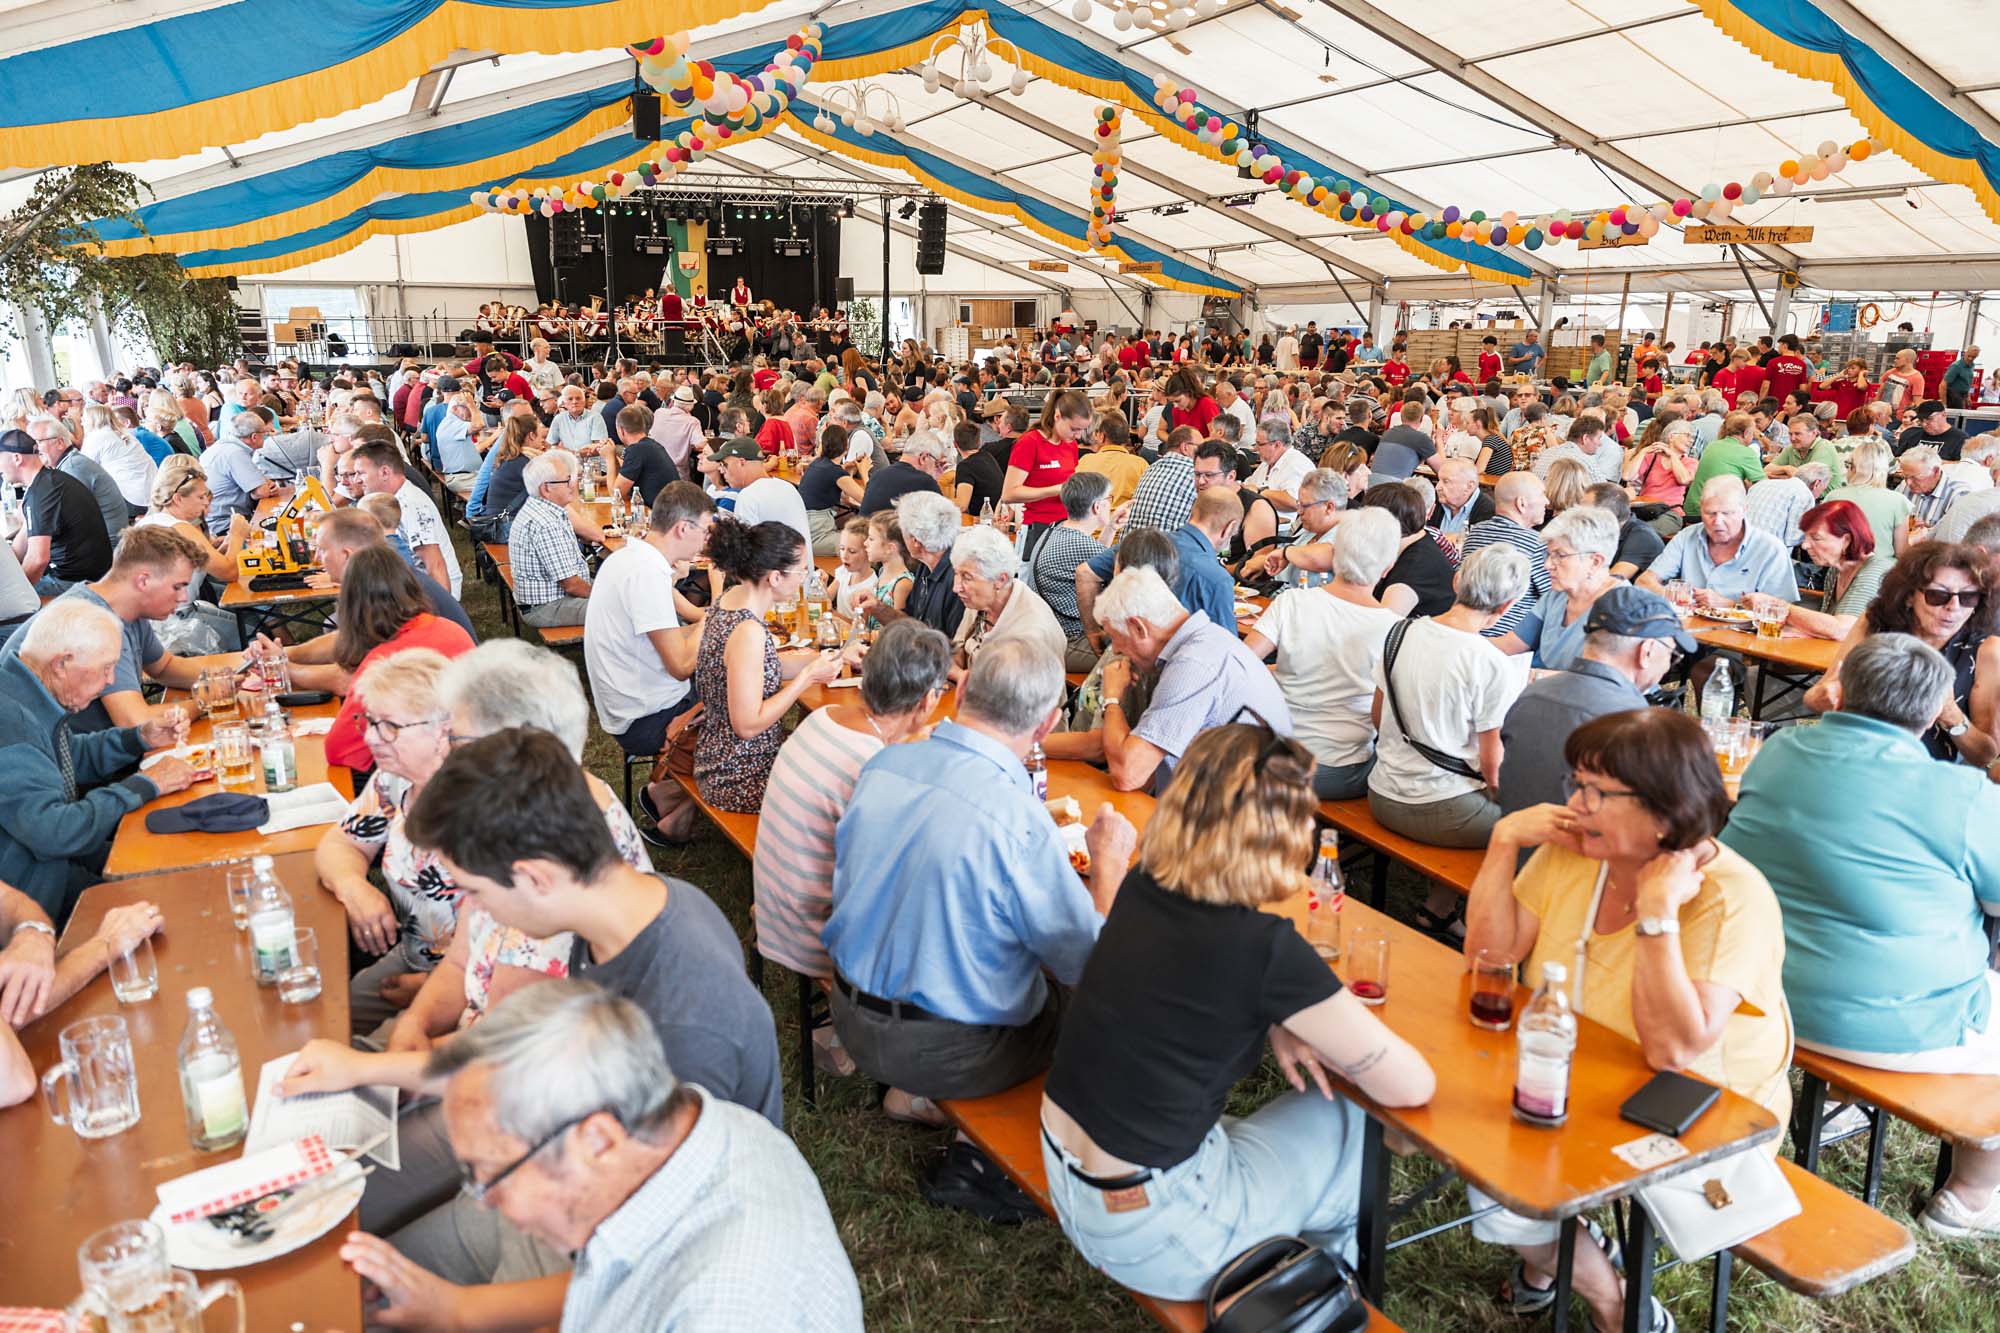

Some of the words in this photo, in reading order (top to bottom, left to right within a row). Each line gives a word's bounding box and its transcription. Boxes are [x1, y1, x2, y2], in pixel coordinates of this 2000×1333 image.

[1704, 228, 1731, 242] Wein
[1744, 228, 1765, 241] Alk
[1768, 228, 1789, 242] frei
